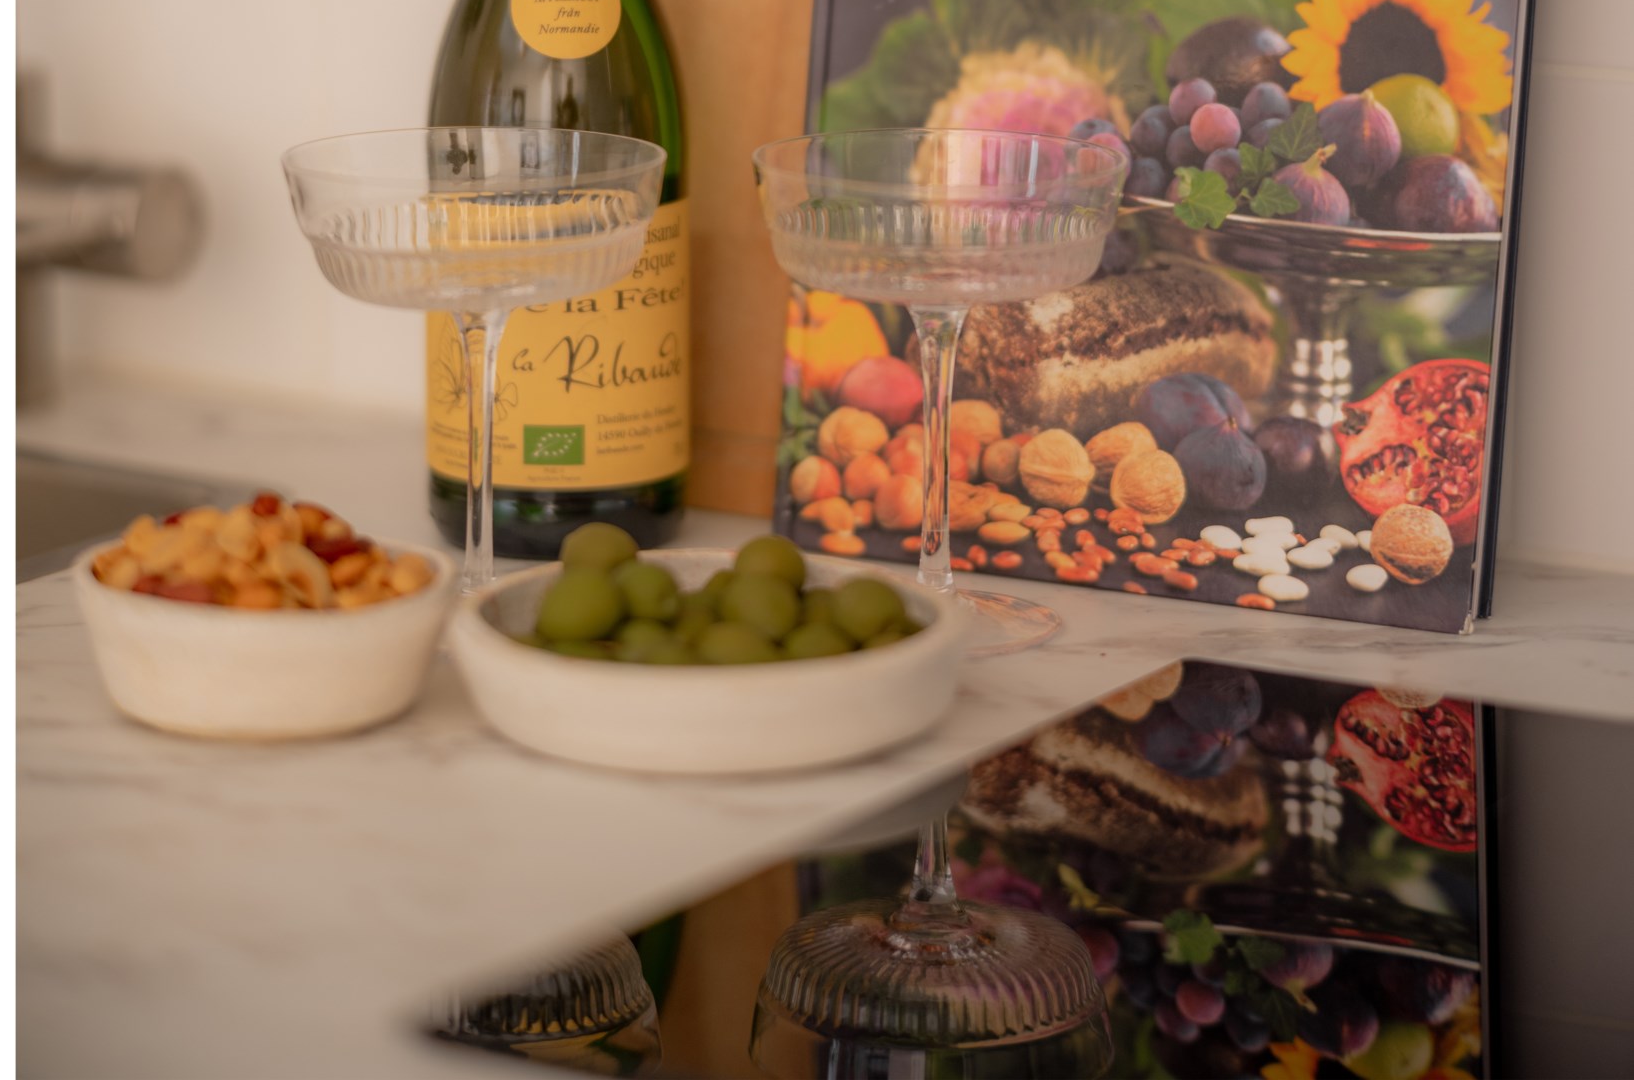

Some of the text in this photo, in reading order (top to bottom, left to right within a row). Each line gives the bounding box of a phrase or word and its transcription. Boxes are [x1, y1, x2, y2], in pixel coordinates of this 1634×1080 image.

[554, 7, 580, 21] från
[538, 23, 600, 35] Normandie
[632, 248, 676, 280] gique
